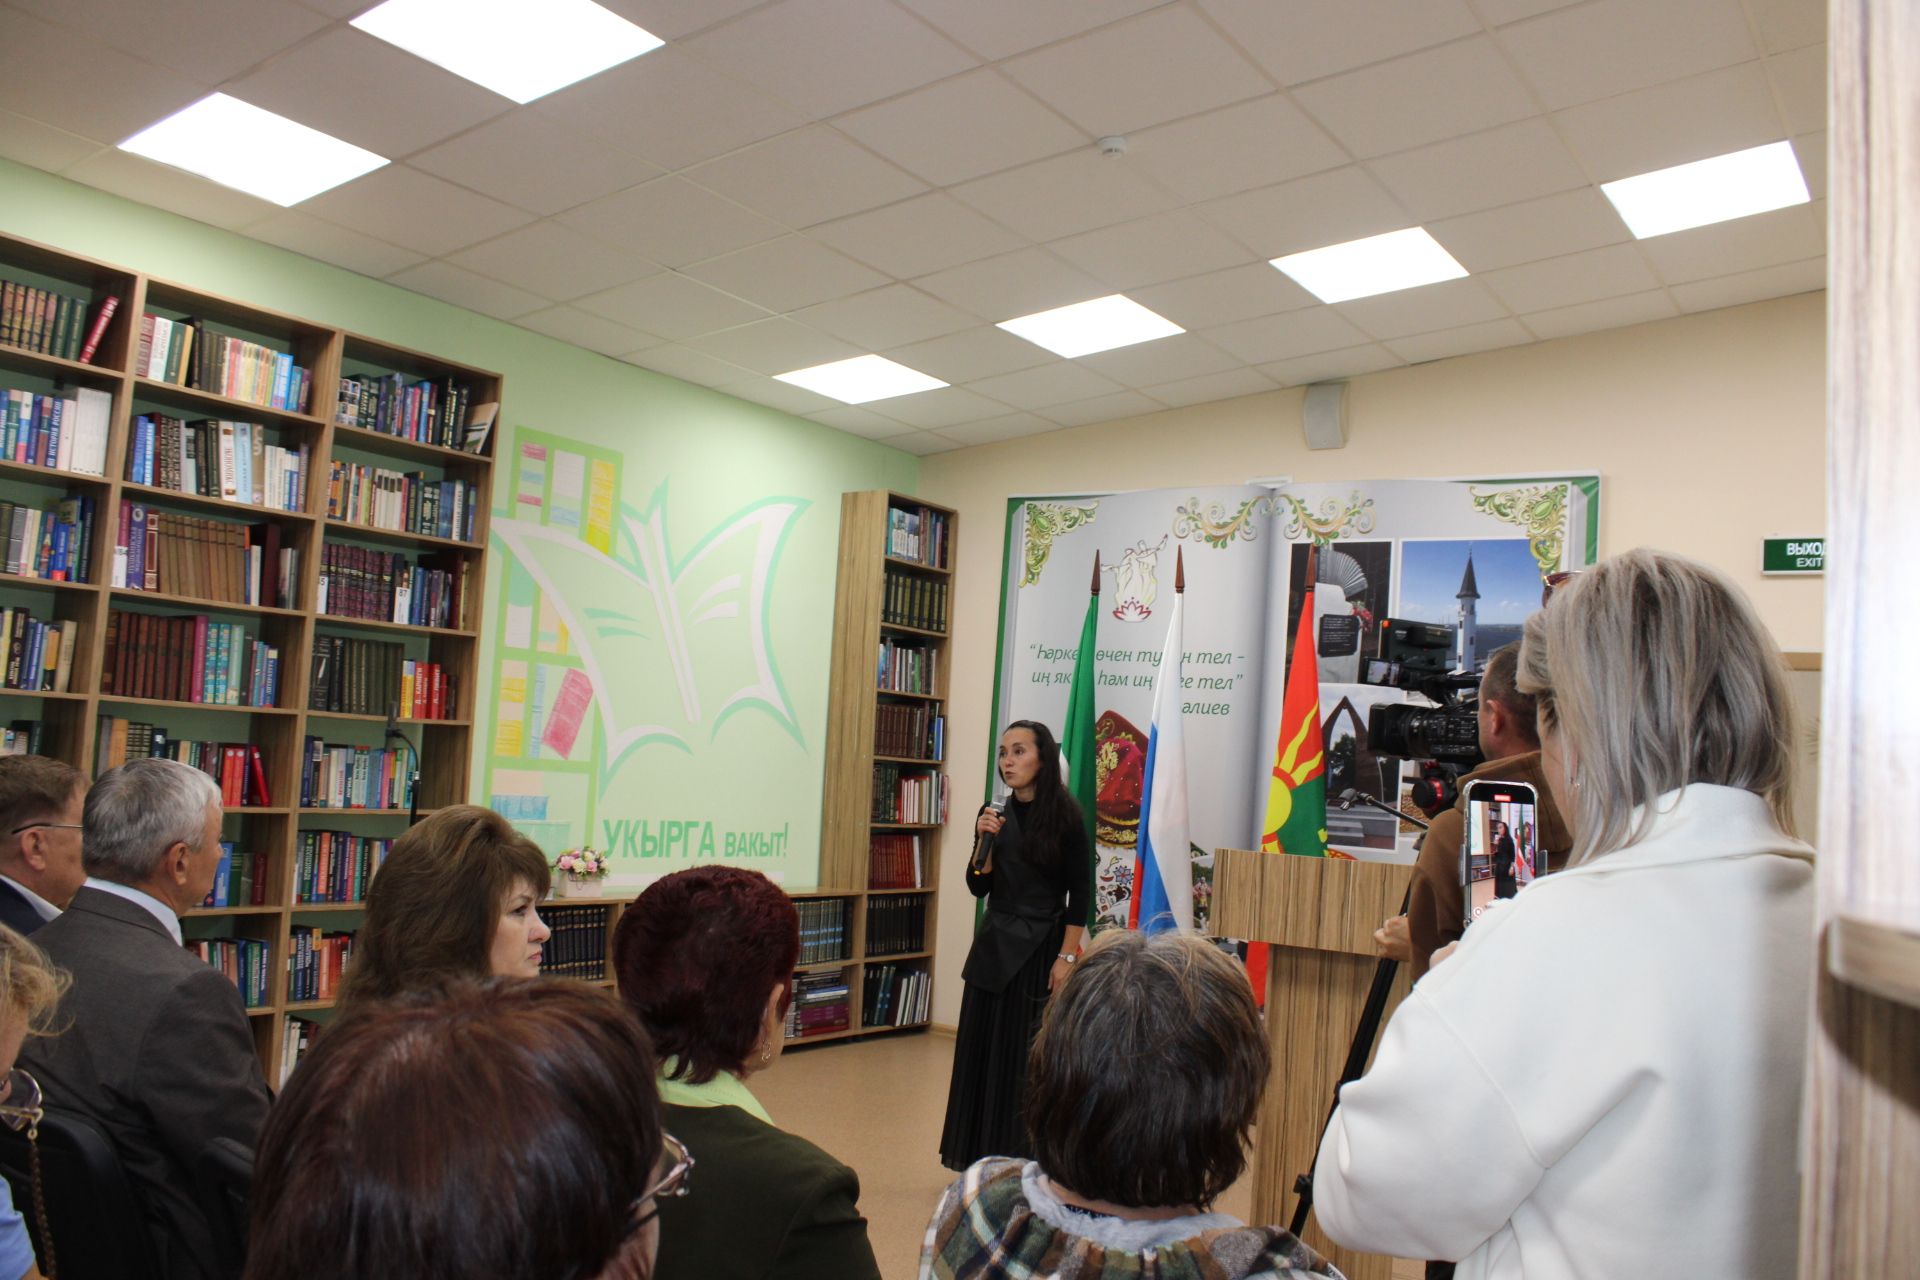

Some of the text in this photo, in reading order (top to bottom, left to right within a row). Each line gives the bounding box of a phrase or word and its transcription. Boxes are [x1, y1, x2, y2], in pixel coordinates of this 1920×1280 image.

[1796, 557, 1824, 568] EXIT
[1095, 649, 1133, 662] өчен
[1195, 652, 1232, 665] тел
[602, 818, 790, 859] УКЫРГА ВАКЫТ!
